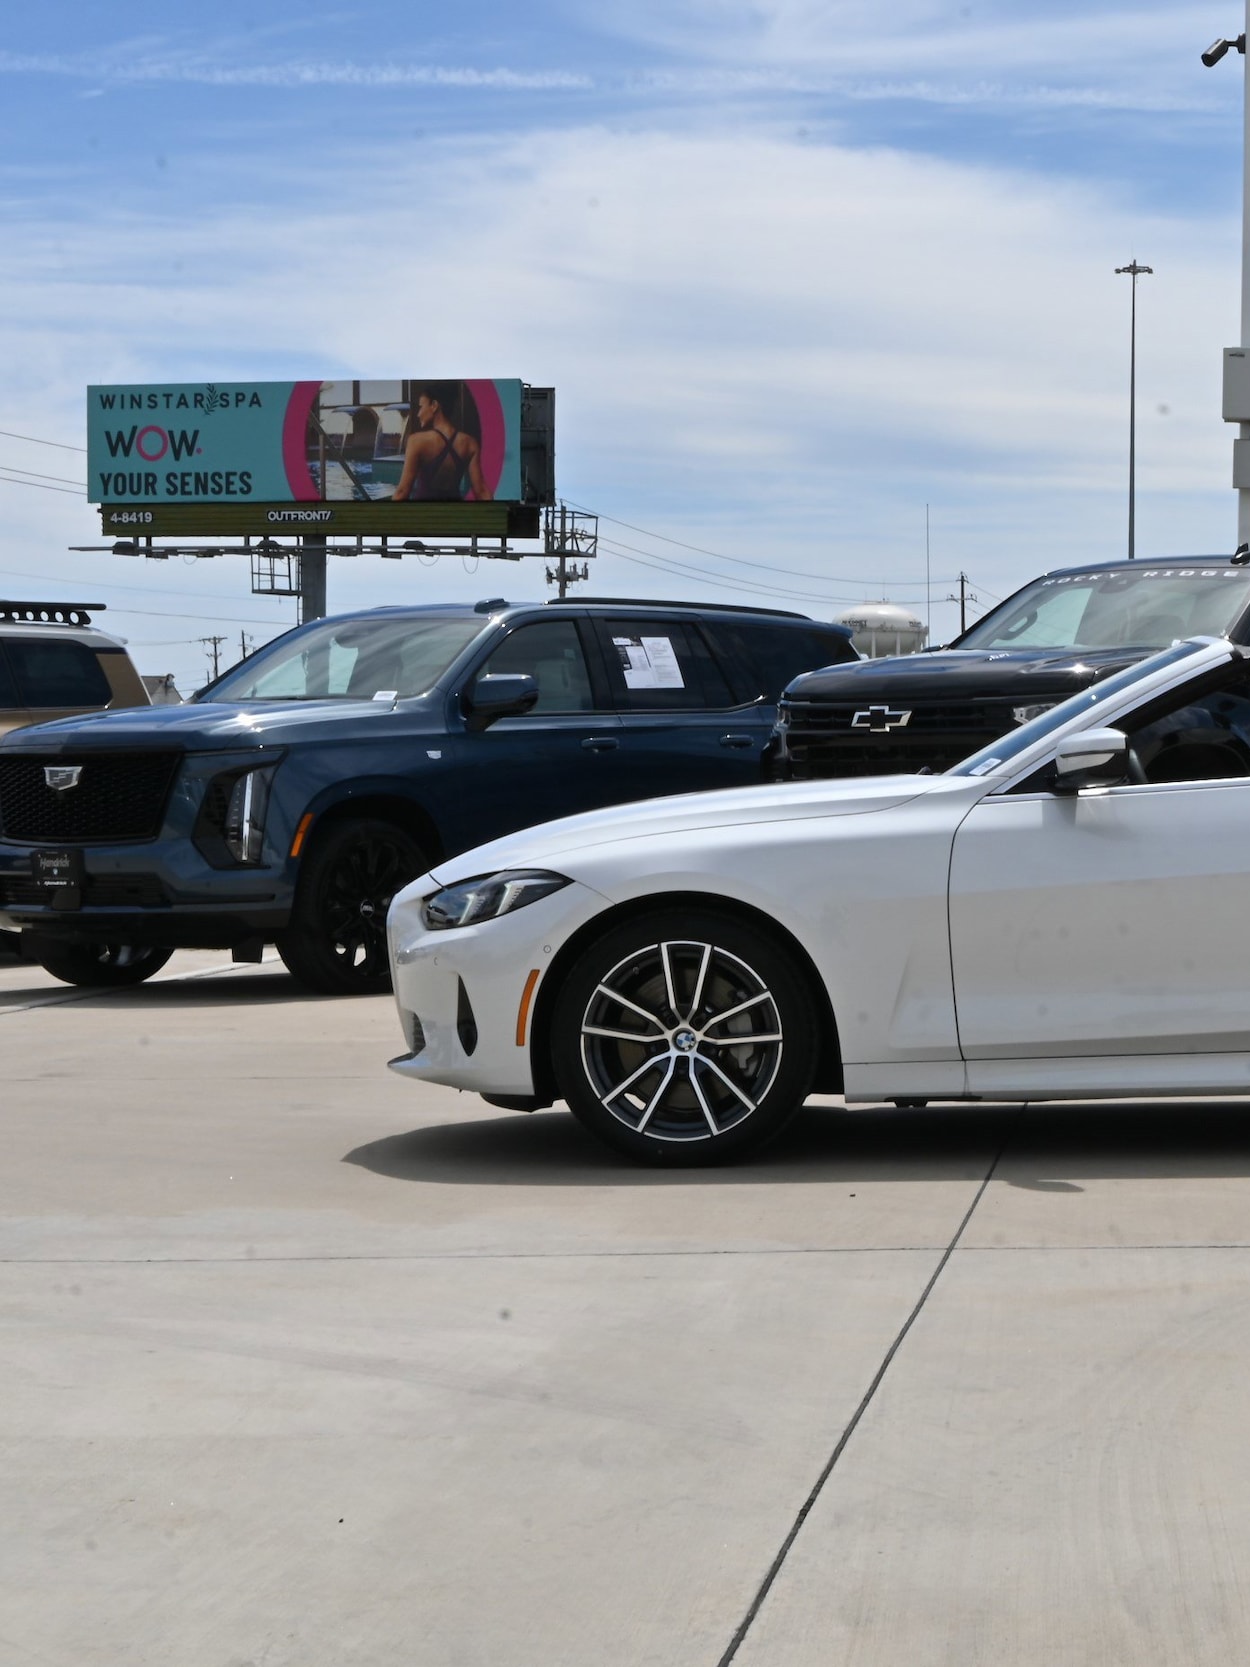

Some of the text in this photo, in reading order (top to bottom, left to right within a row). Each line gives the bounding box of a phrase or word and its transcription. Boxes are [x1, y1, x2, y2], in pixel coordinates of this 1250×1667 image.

[100, 391, 262, 410] WINSTAR SPA
[100, 471, 253, 496] YOUR SENSES
[110, 511, 153, 523] 4-8419
[1142, 570, 1240, 578] RIDGE
